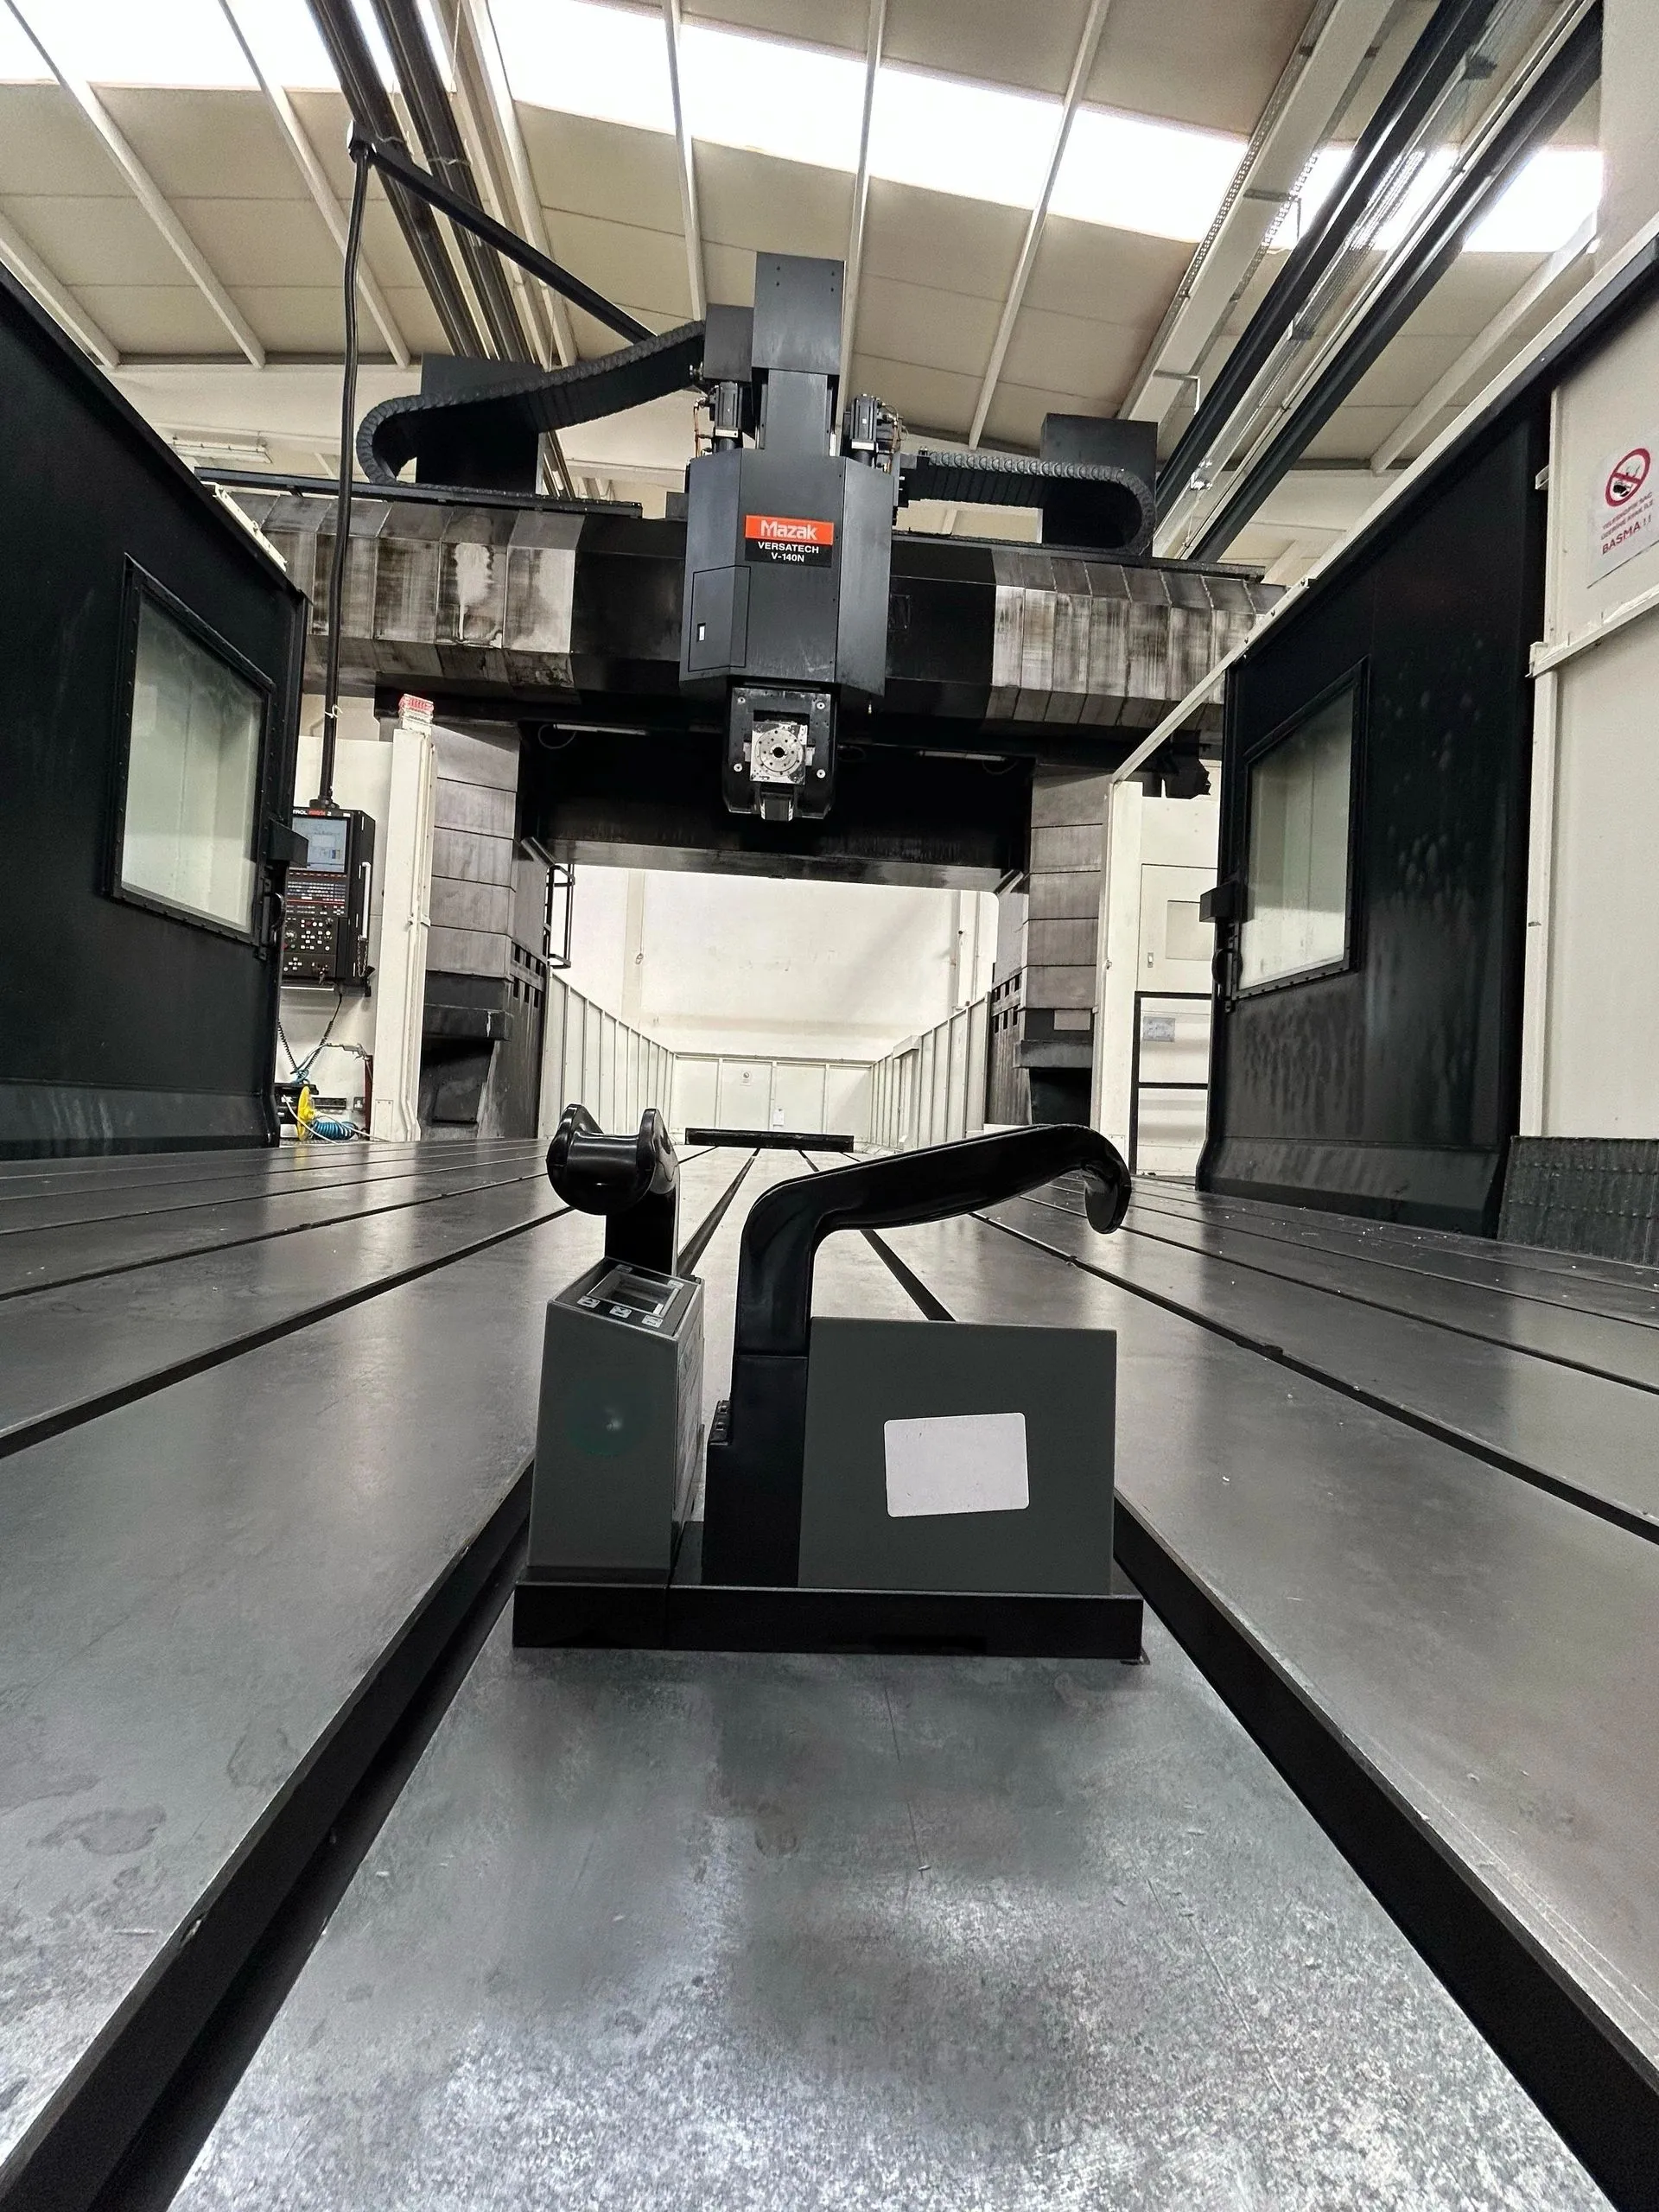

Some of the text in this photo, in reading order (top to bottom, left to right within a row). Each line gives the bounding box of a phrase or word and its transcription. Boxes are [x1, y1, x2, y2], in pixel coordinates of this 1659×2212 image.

[760, 519, 818, 541] Mazak
[1602, 521, 1641, 555] BASMA
[758, 541, 819, 554] VERSATECH
[772, 552, 804, 562] V-140N
